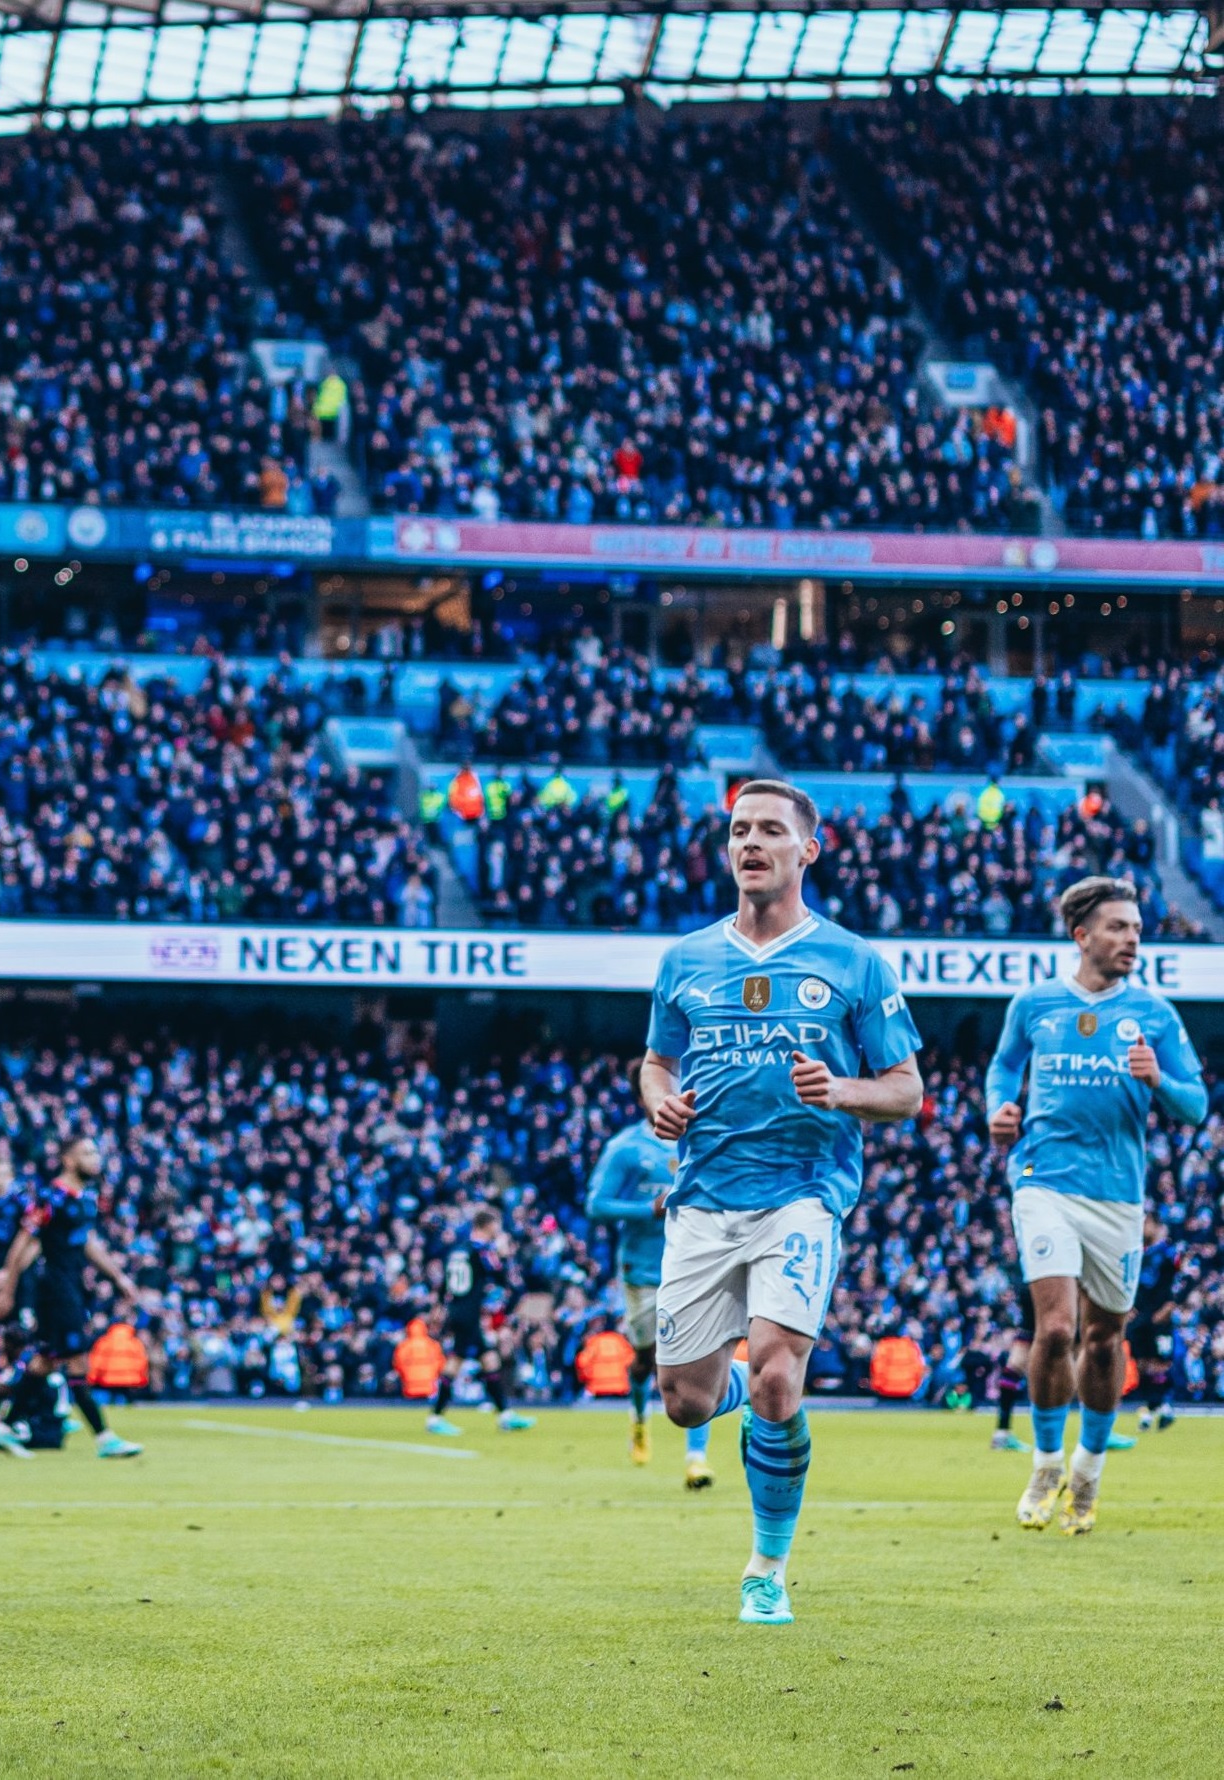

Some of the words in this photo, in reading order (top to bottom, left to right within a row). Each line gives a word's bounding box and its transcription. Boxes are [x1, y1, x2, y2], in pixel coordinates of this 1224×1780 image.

[238, 936, 402, 974] NEXEN
[419, 940, 527, 977] TIRE
[901, 950, 1057, 985] NEXEN
[694, 1022, 828, 1049] ETIHAD
[711, 1050, 790, 1066] AIRWAY
[1051, 1074, 1119, 1087] AIRWAYS
[781, 1232, 824, 1287] 21
